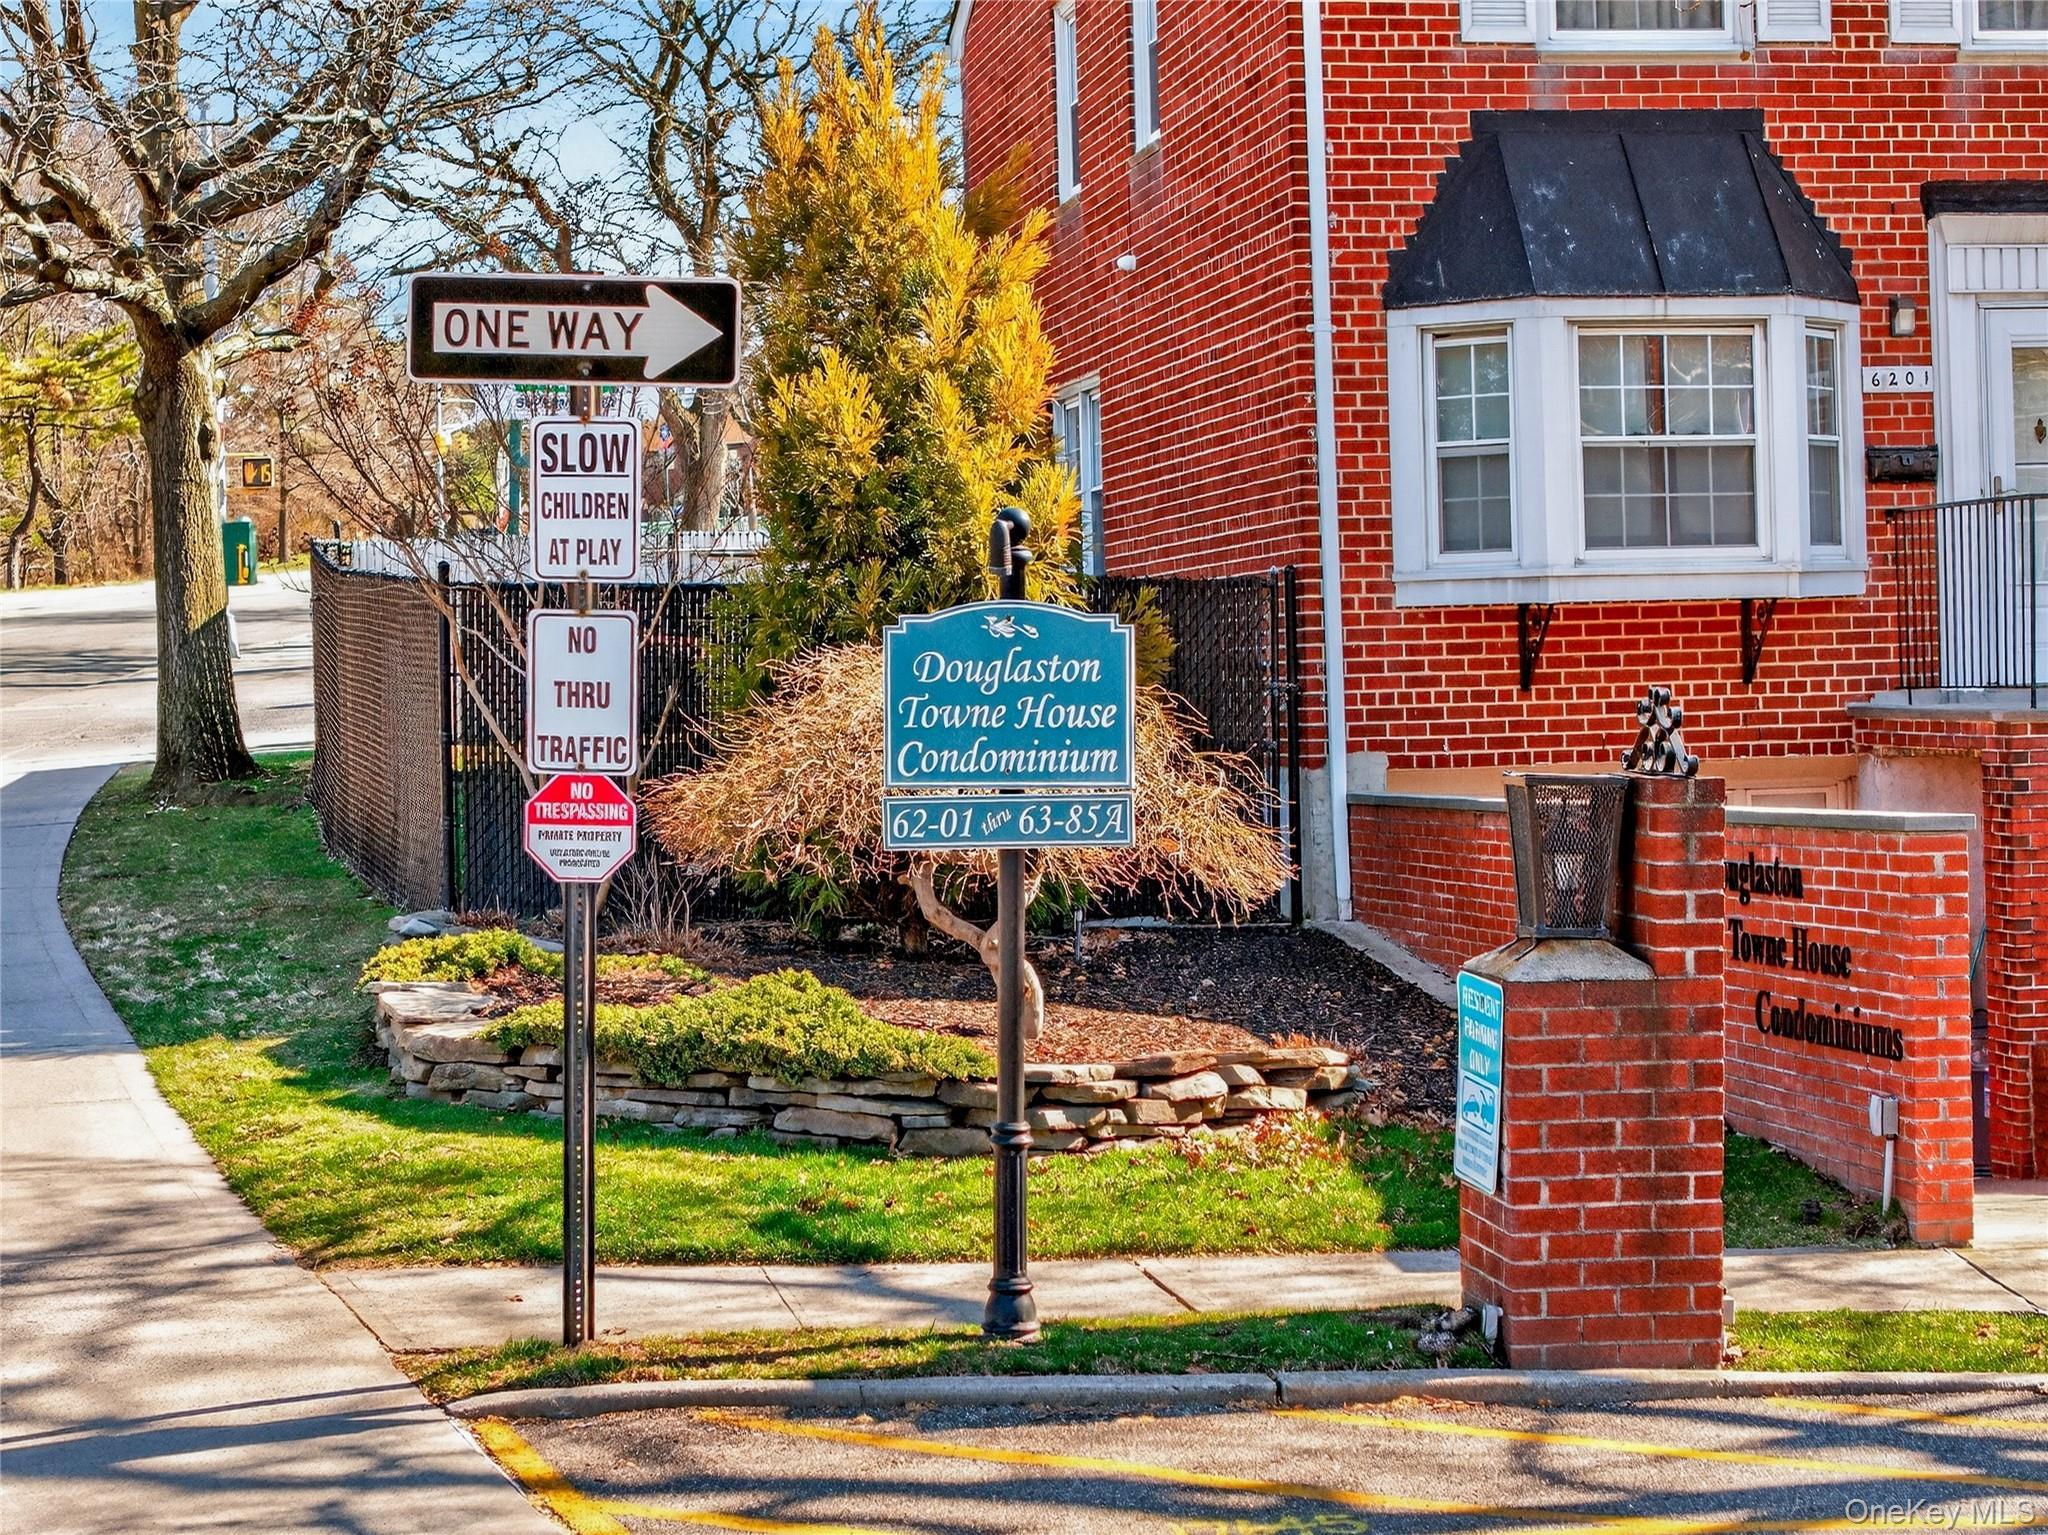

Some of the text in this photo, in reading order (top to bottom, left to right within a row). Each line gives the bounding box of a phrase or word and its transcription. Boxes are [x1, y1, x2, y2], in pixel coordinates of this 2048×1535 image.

[444, 308, 645, 351] ONE WAY
[1871, 371, 1929, 387] 6201
[540, 433, 630, 473] SLOW
[540, 491, 630, 520] CHILDREN
[548, 538, 622, 566] AT PLAY
[567, 625, 597, 654] NO
[913, 646, 1102, 696] Douglaston
[553, 680, 611, 710] THRU
[898, 693, 1118, 730] Towne House
[537, 735, 627, 764] TRAFFIC
[897, 736, 1119, 777] Condominium
[570, 782, 594, 800] NO
[534, 801, 629, 820] TRESPASSING
[892, 803, 1125, 839] 62-01 thru 63-85A
[576, 830, 623, 842] PROPERTY
[1728, 918, 1853, 979] Towne House
[1462, 984, 1501, 1021] RESIDENT
[1755, 990, 1904, 1062] Condominiums
[1469, 1047, 1491, 1078] ONLY
